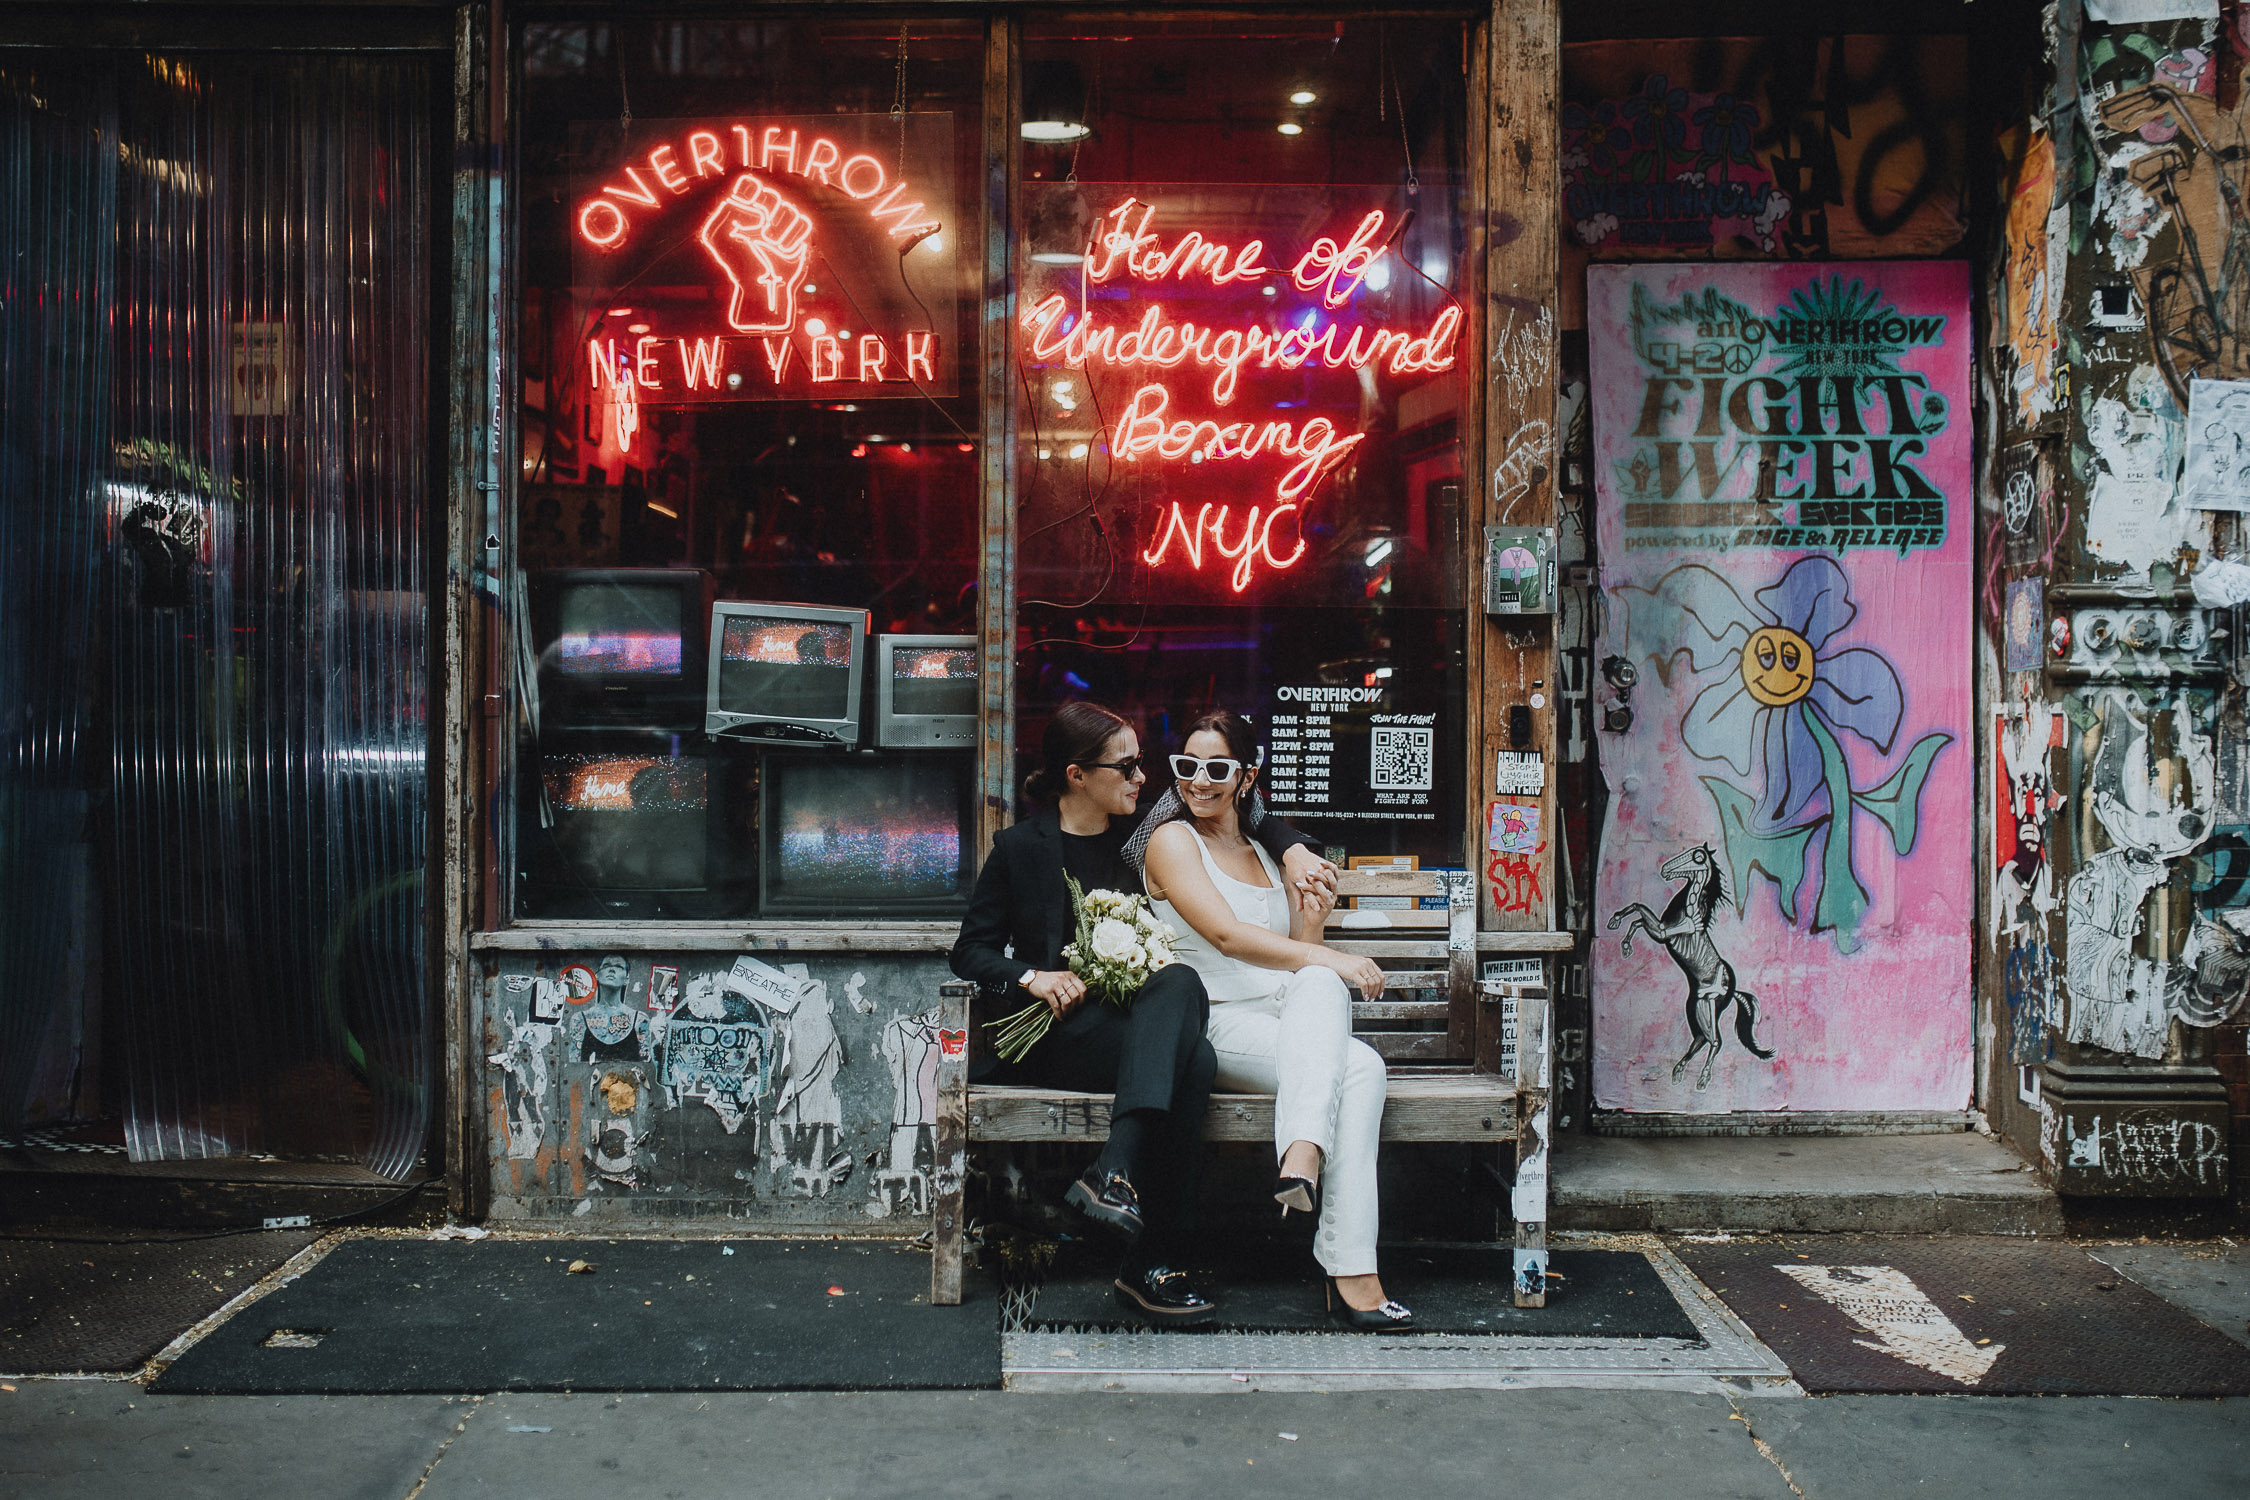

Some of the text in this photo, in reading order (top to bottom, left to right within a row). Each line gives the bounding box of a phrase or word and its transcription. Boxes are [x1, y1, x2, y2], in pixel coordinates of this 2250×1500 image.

[580, 125, 941, 245] OVERTHROW
[1567, 181, 1770, 220] OVERTHROW
[1086, 197, 1390, 308] Home of
[1697, 318, 1945, 345] an OVERTHROW
[588, 333, 936, 390] NEW YORK
[1021, 294, 1462, 406] Underground
[1806, 351, 1877, 364] NEW YORK
[1631, 376, 1928, 436] FIGHT
[1113, 383, 1366, 500] Boxing
[1655, 439, 1945, 501] WEEK
[1143, 502, 1306, 592] NYC
[1625, 532, 1704, 552] powered
[1709, 532, 1731, 553] by
[1829, 529, 1944, 557] RELEASE
[759, 634, 795, 655] Home
[1272, 716, 1297, 725] 9AM
[1305, 716, 1331, 725] 8PM
[1310, 703, 1349, 713] NEW YORK
[1370, 713, 1436, 725] JOIN THE FIGHT!
[1272, 729, 1297, 737] 8AM
[1305, 729, 1331, 738] 9PM
[1272, 742, 1301, 751] 12PM
[1308, 742, 1334, 751] 8PM
[1271, 768, 1297, 776] 8AM
[1305, 768, 1330, 777] 8PM
[1272, 755, 1297, 764] 8AM
[1305, 756, 1330, 764] 9PM
[580, 774, 627, 800] Home
[1271, 781, 1296, 790] 9AM
[1304, 781, 1329, 790] 3PM
[1271, 793, 1296, 802] 9AM
[1304, 794, 1329, 803] 2PM
[1487, 861, 1543, 915] SIX
[1485, 959, 1541, 974] WHERE IN THE
[732, 963, 795, 1003] BREATHE
